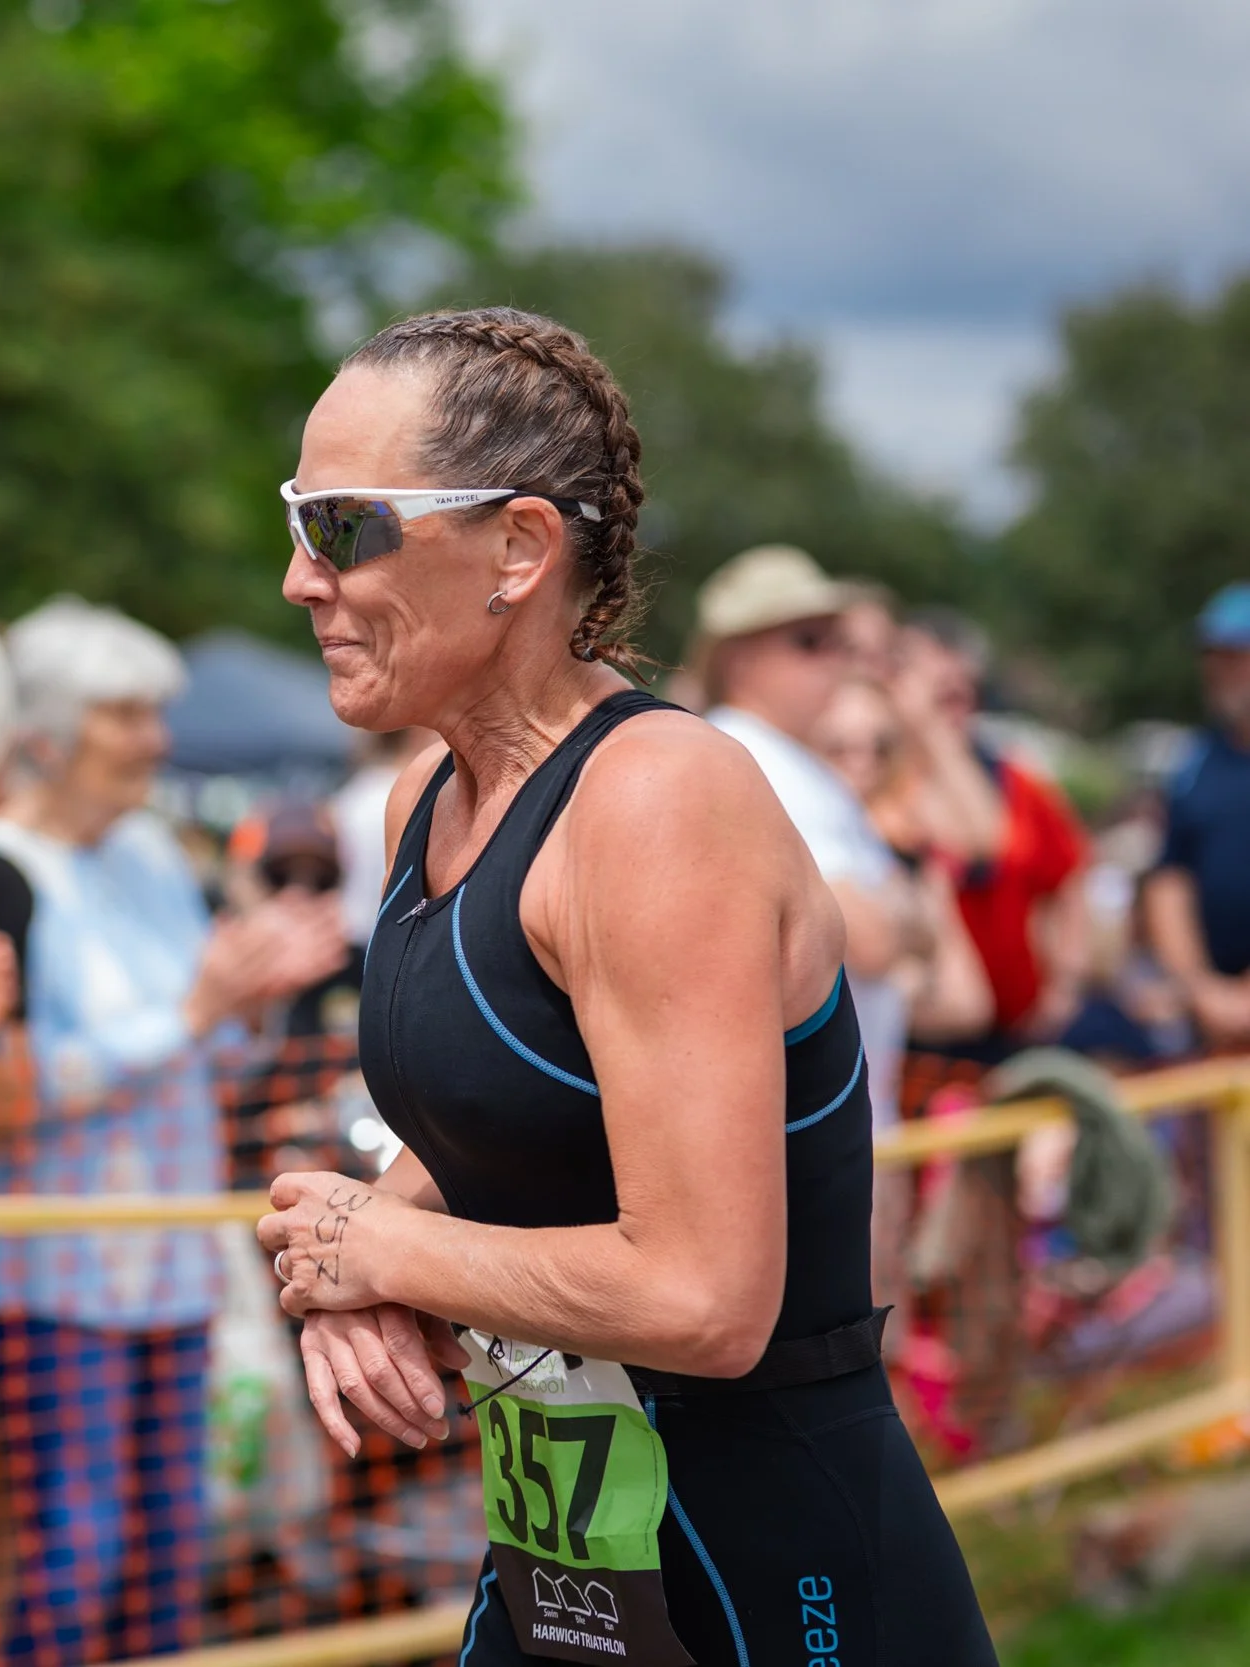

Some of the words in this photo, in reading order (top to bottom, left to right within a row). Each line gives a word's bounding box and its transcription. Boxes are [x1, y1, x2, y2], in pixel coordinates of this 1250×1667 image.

[435, 496, 453, 504] VAN
[454, 494, 481, 503] RYSEL
[489, 1399, 617, 1561] 357
[544, 1608, 559, 1618] Swim
[575, 1615, 586, 1625] Bike
[605, 1621, 614, 1631] Run
[532, 1623, 580, 1645] HARWICH
[580, 1632, 626, 1656] TRIATHLON
